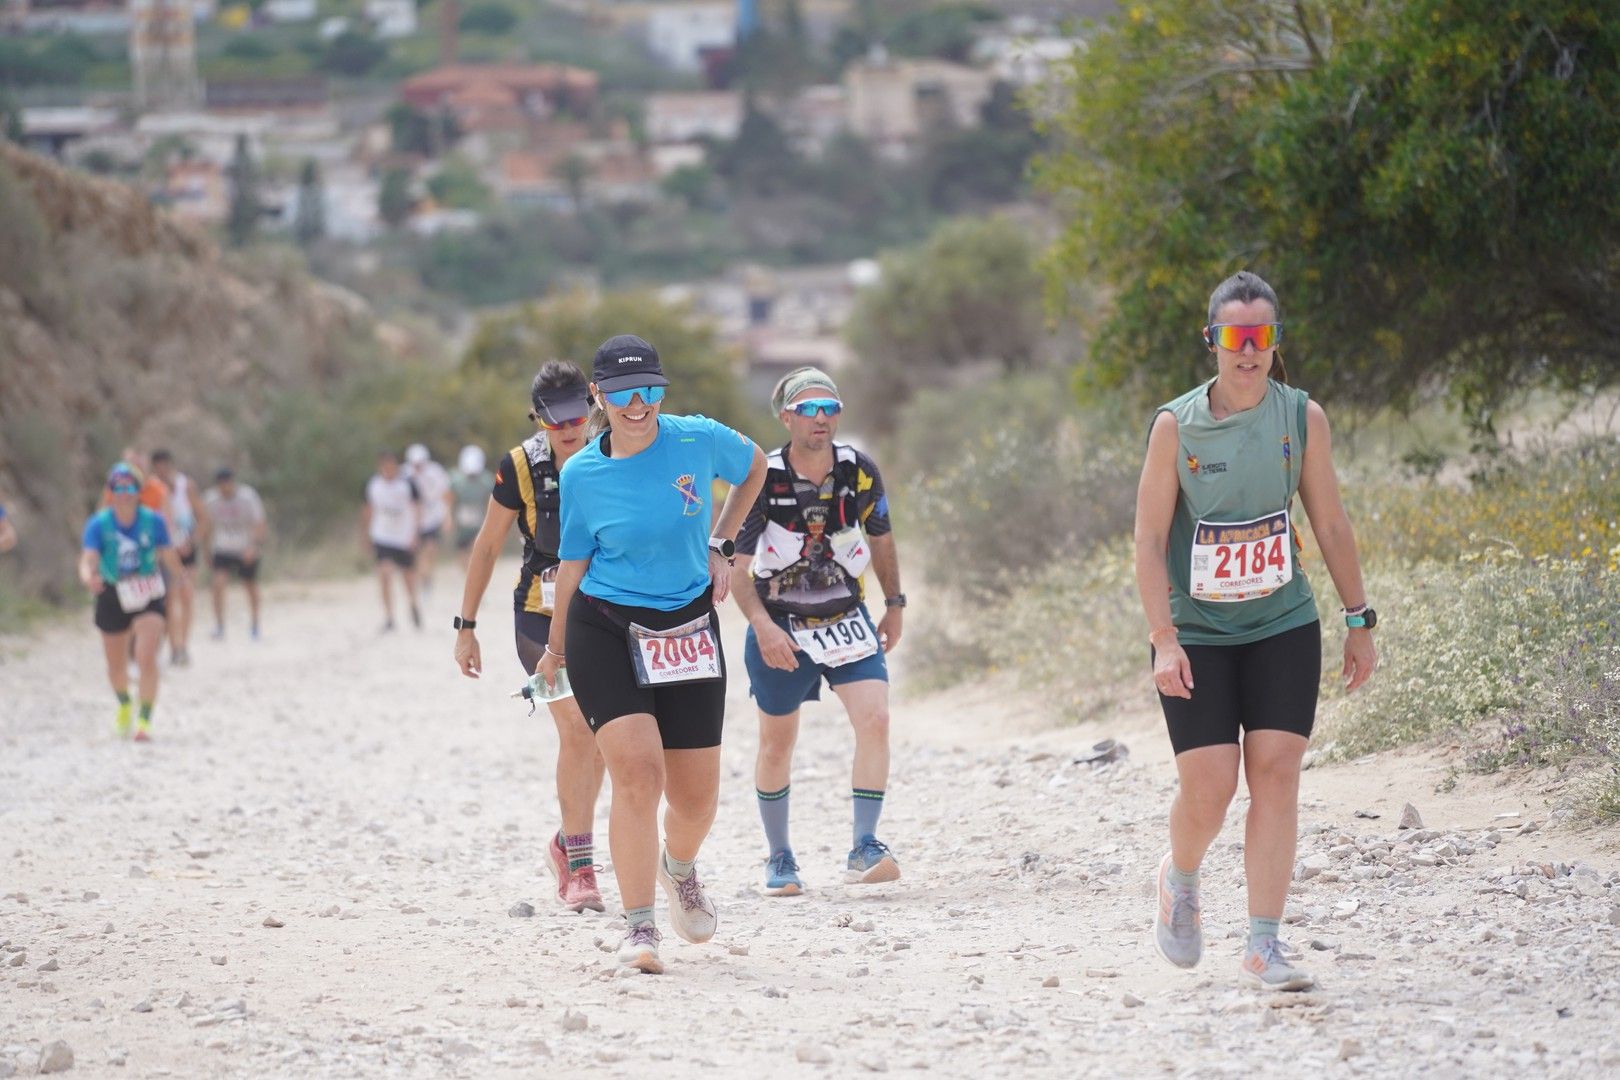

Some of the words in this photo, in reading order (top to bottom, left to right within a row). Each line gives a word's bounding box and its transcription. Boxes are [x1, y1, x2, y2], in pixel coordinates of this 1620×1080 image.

[1200, 528, 1215, 544] LA
[1214, 535, 1285, 578] 2184
[1220, 576, 1264, 588] CORREDORES
[812, 620, 867, 650] 1190
[646, 631, 715, 670] 2004
[659, 664, 700, 678] CORREDORES
